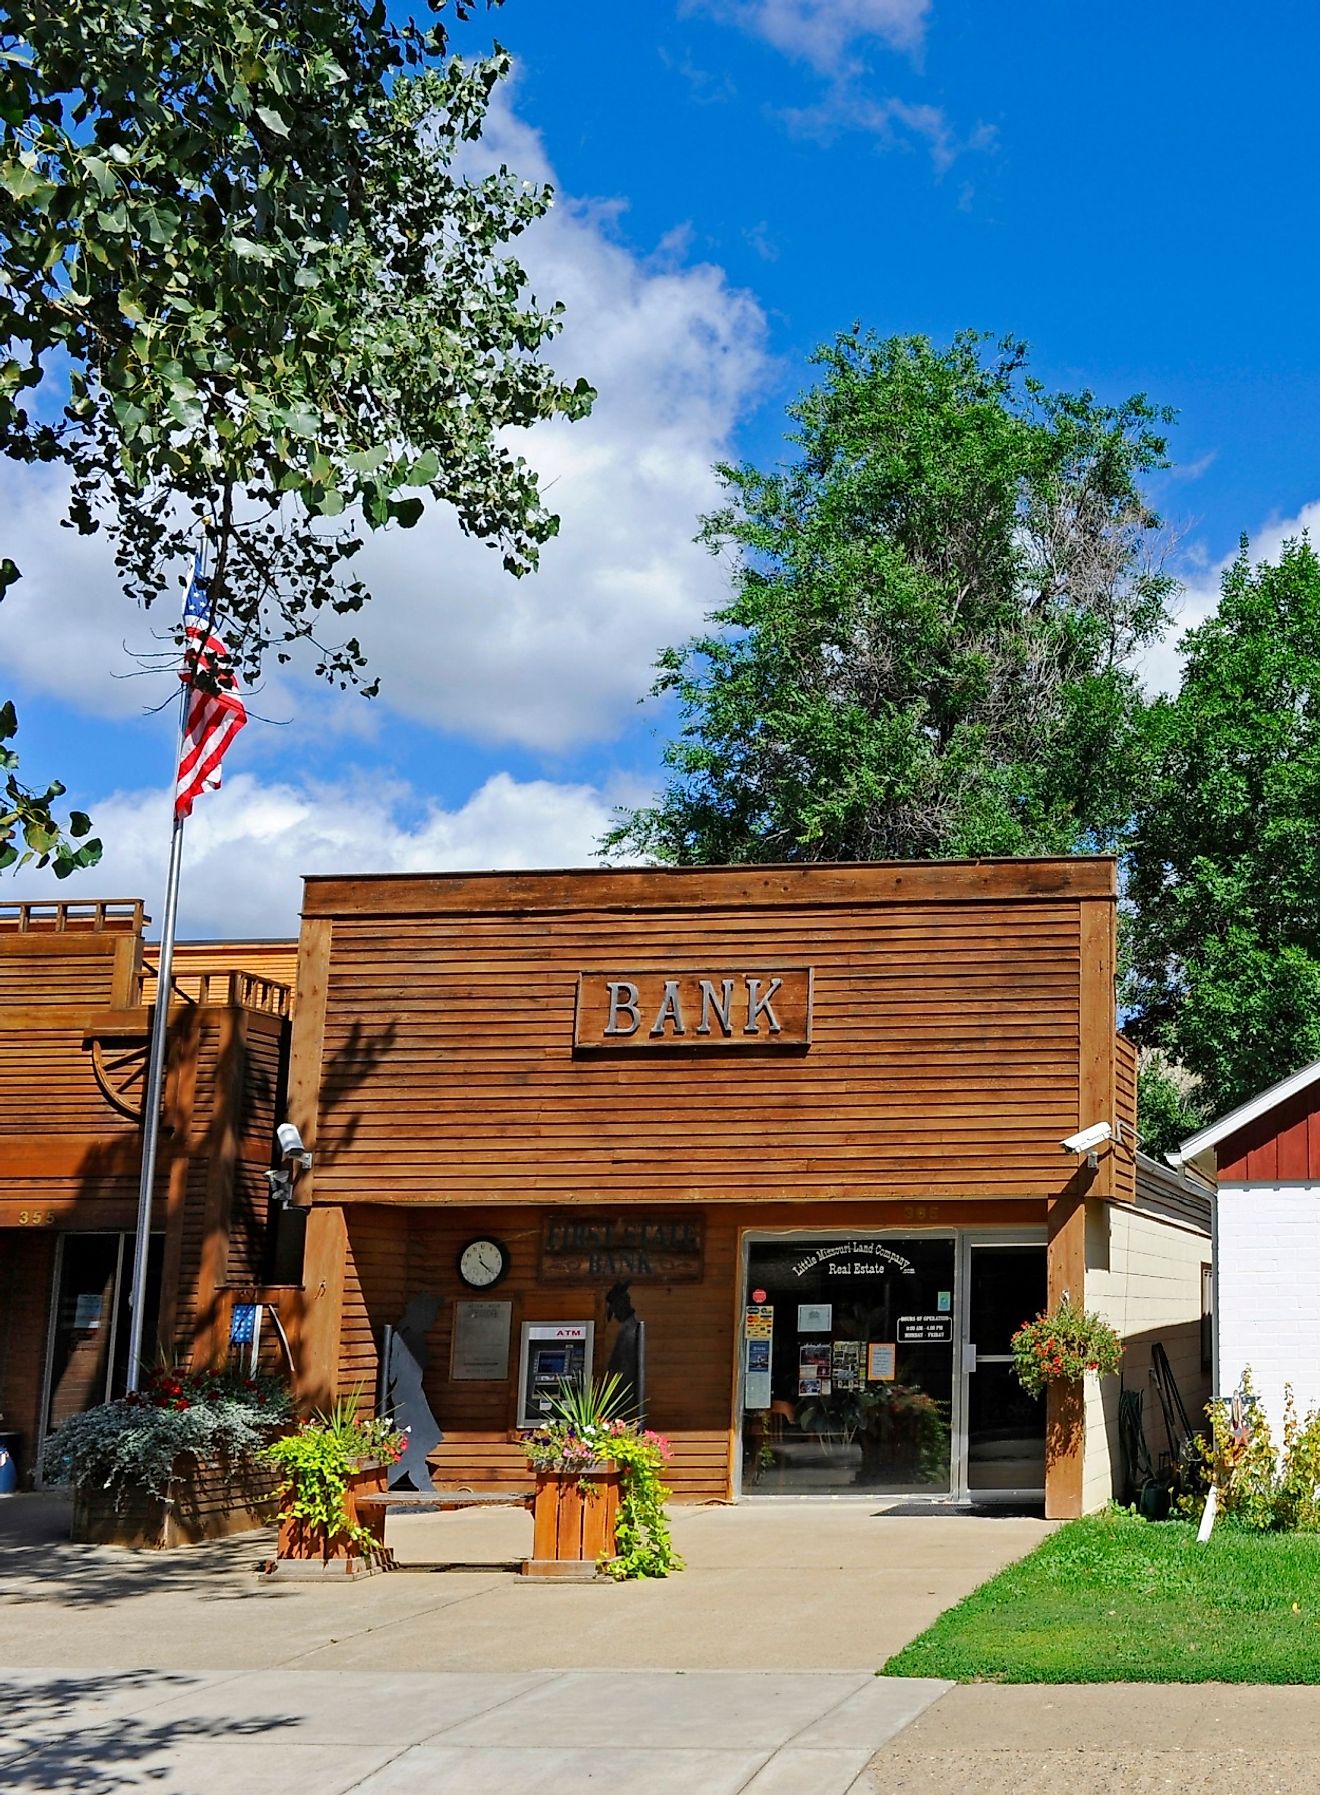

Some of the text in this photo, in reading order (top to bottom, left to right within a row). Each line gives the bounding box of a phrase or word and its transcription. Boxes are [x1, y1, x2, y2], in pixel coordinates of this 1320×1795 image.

[603, 977, 784, 1037] BANK
[19, 1211, 55, 1224] 355
[588, 1251, 652, 1274] BANK
[791, 1256, 818, 1277] Little
[815, 1243, 851, 1261] Missouri
[852, 1242, 874, 1255] Land
[875, 1244, 911, 1270] Company
[828, 1262, 885, 1275] Real Estate
